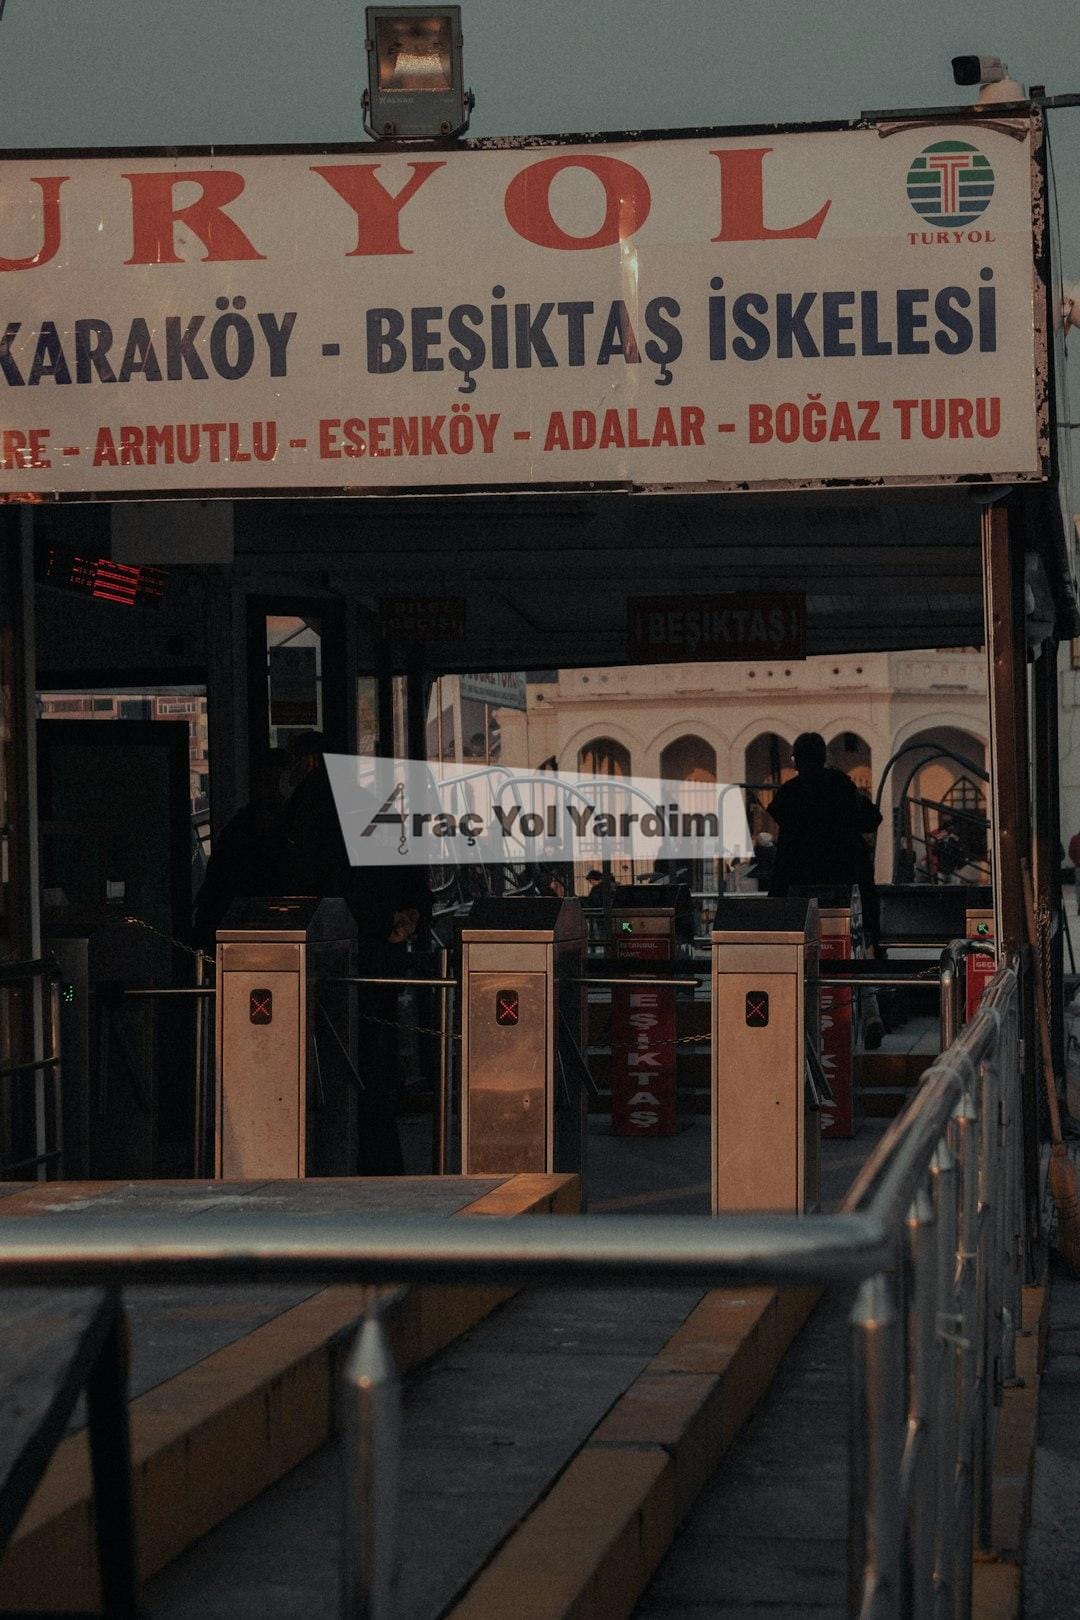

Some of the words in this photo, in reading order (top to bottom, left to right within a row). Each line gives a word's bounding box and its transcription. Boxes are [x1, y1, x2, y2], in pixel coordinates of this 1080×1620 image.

[907, 230, 996, 245] TURYOL
[0, 296, 297, 387] KARAKÖY
[366, 285, 683, 394] BEŞİKTAŞ
[709, 266, 997, 361] İSKELESİ
[0, 429, 51, 469] RE
[92, 421, 277, 467] ARMUTLU
[319, 403, 501, 459] ESENKÖY
[543, 405, 705, 451] ADALAR
[749, 393, 880, 444] BOĞAZ
[893, 397, 1001, 441] TURU
